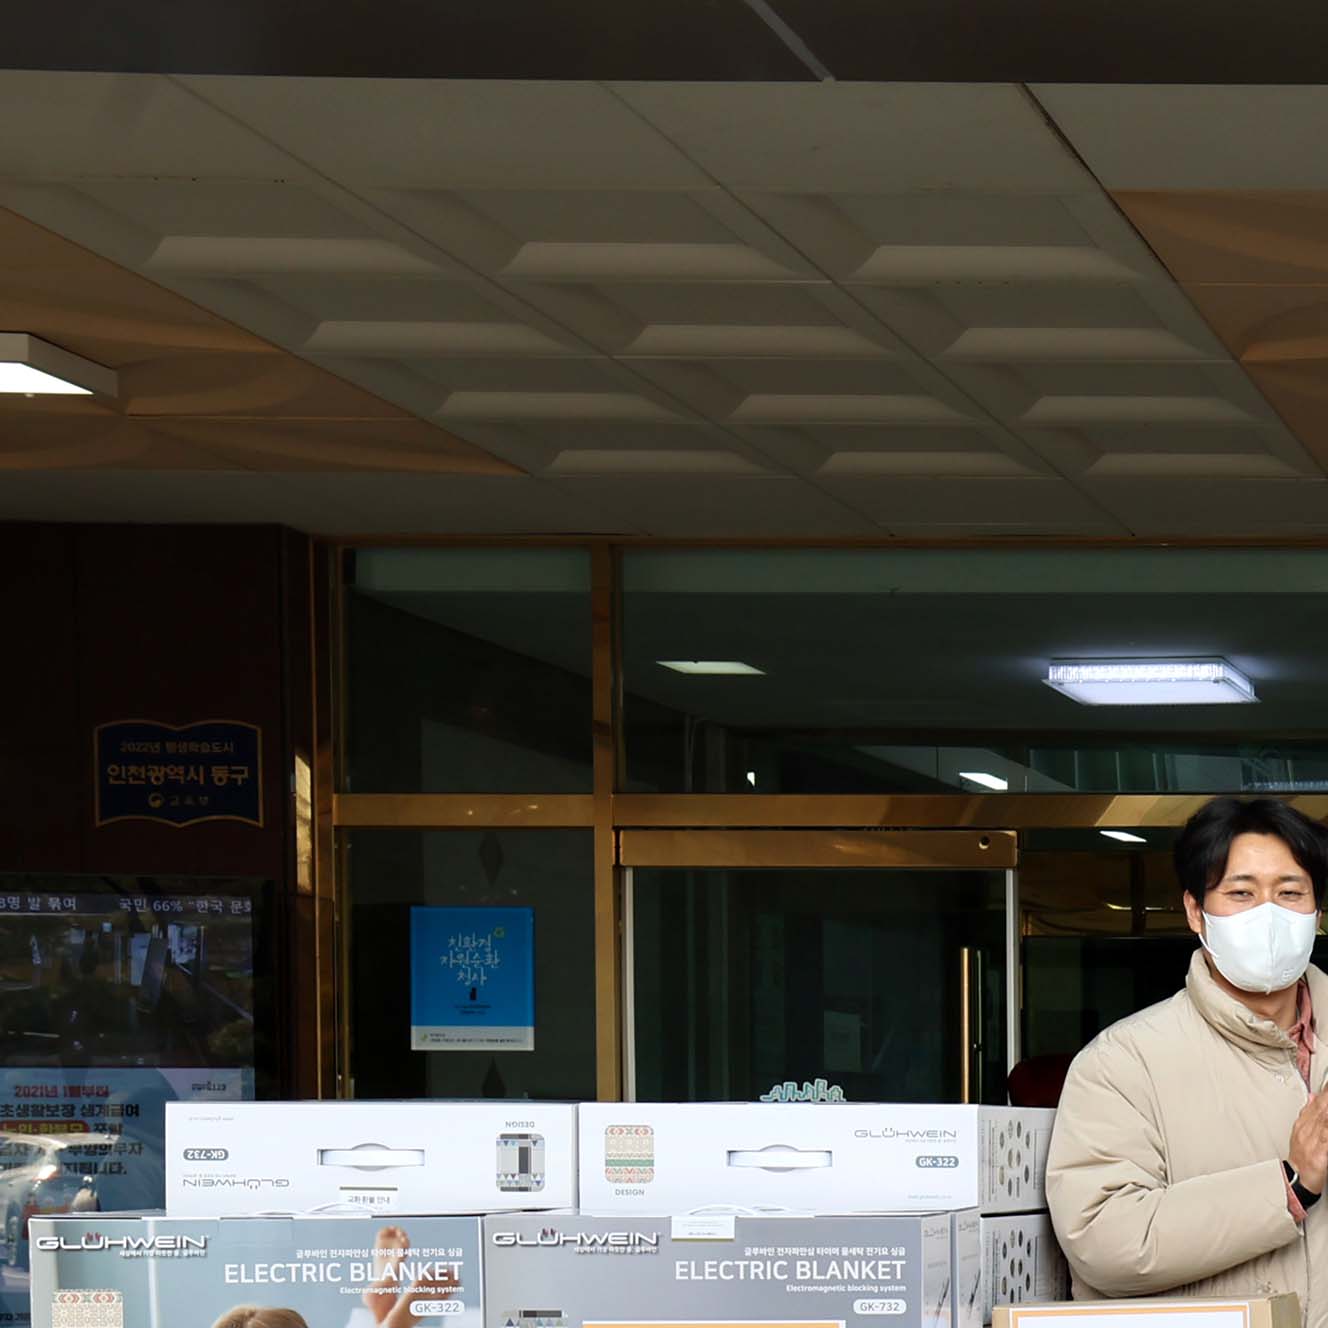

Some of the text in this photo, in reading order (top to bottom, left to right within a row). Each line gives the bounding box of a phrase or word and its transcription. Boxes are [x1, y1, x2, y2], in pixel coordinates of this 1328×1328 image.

[106, 763, 249, 786] 인천광역시 동구
[917, 1156, 957, 1168] GK-322
[614, 1188, 645, 1197] DESIGN
[35, 1231, 208, 1250] GLÜHWEIN
[224, 1260, 465, 1284] ELECTRIC BLANKET
[413, 1301, 461, 1314] GK-322
